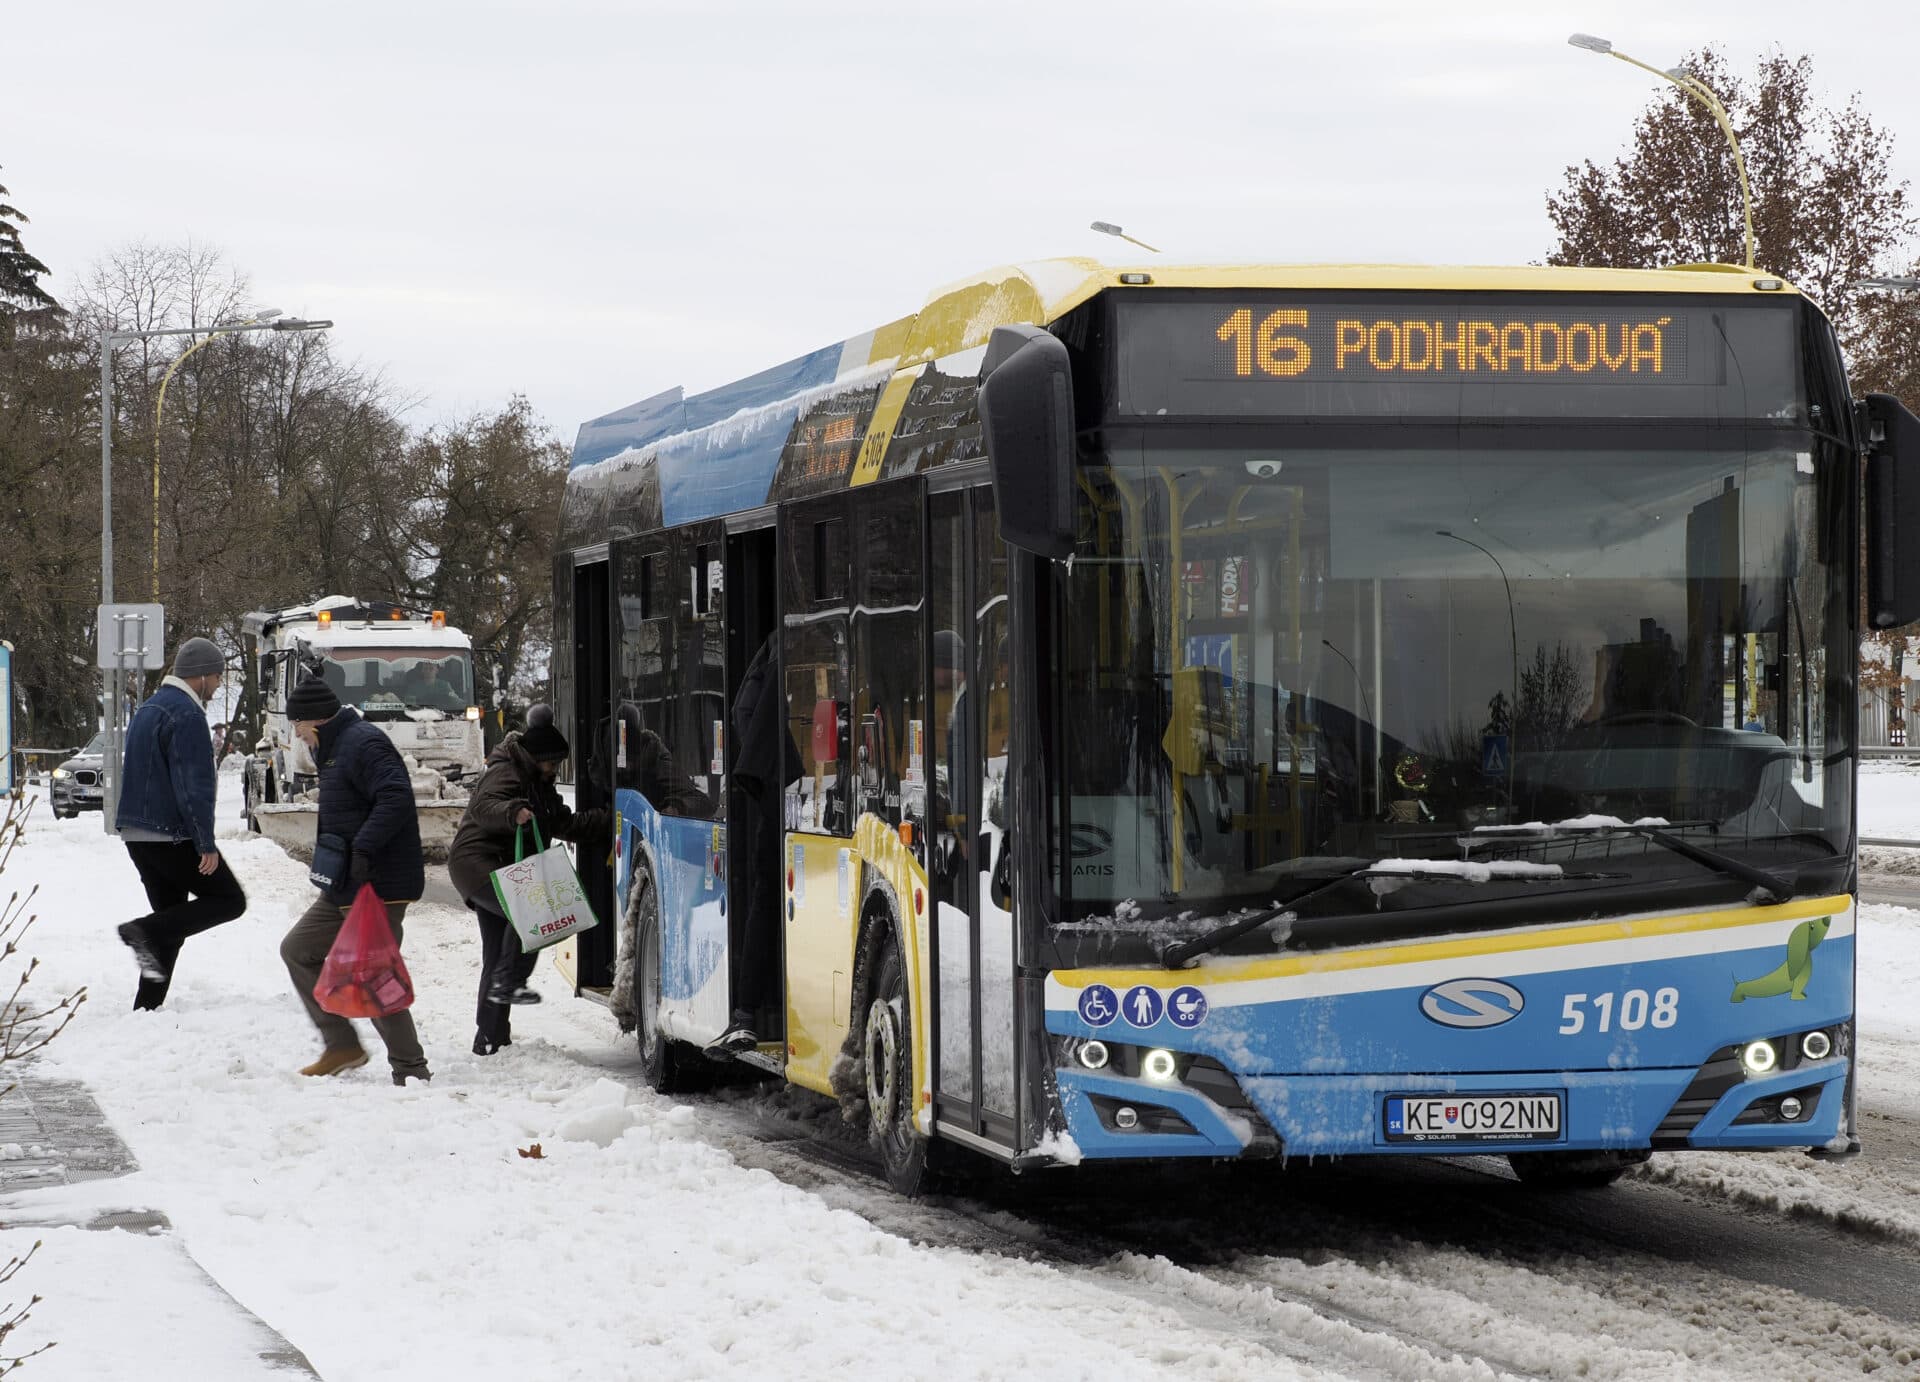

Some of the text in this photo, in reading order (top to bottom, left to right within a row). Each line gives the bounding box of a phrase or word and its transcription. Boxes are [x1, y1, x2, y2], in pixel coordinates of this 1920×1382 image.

[1217, 309, 1672, 376] 16 PODHRADOVÁ
[863, 431, 886, 470] 5108
[540, 914, 577, 936] FRESH
[1559, 987, 1679, 1035] 5108
[1390, 1120, 1401, 1129] SK
[1407, 1100, 1553, 1130] KE 092NN
